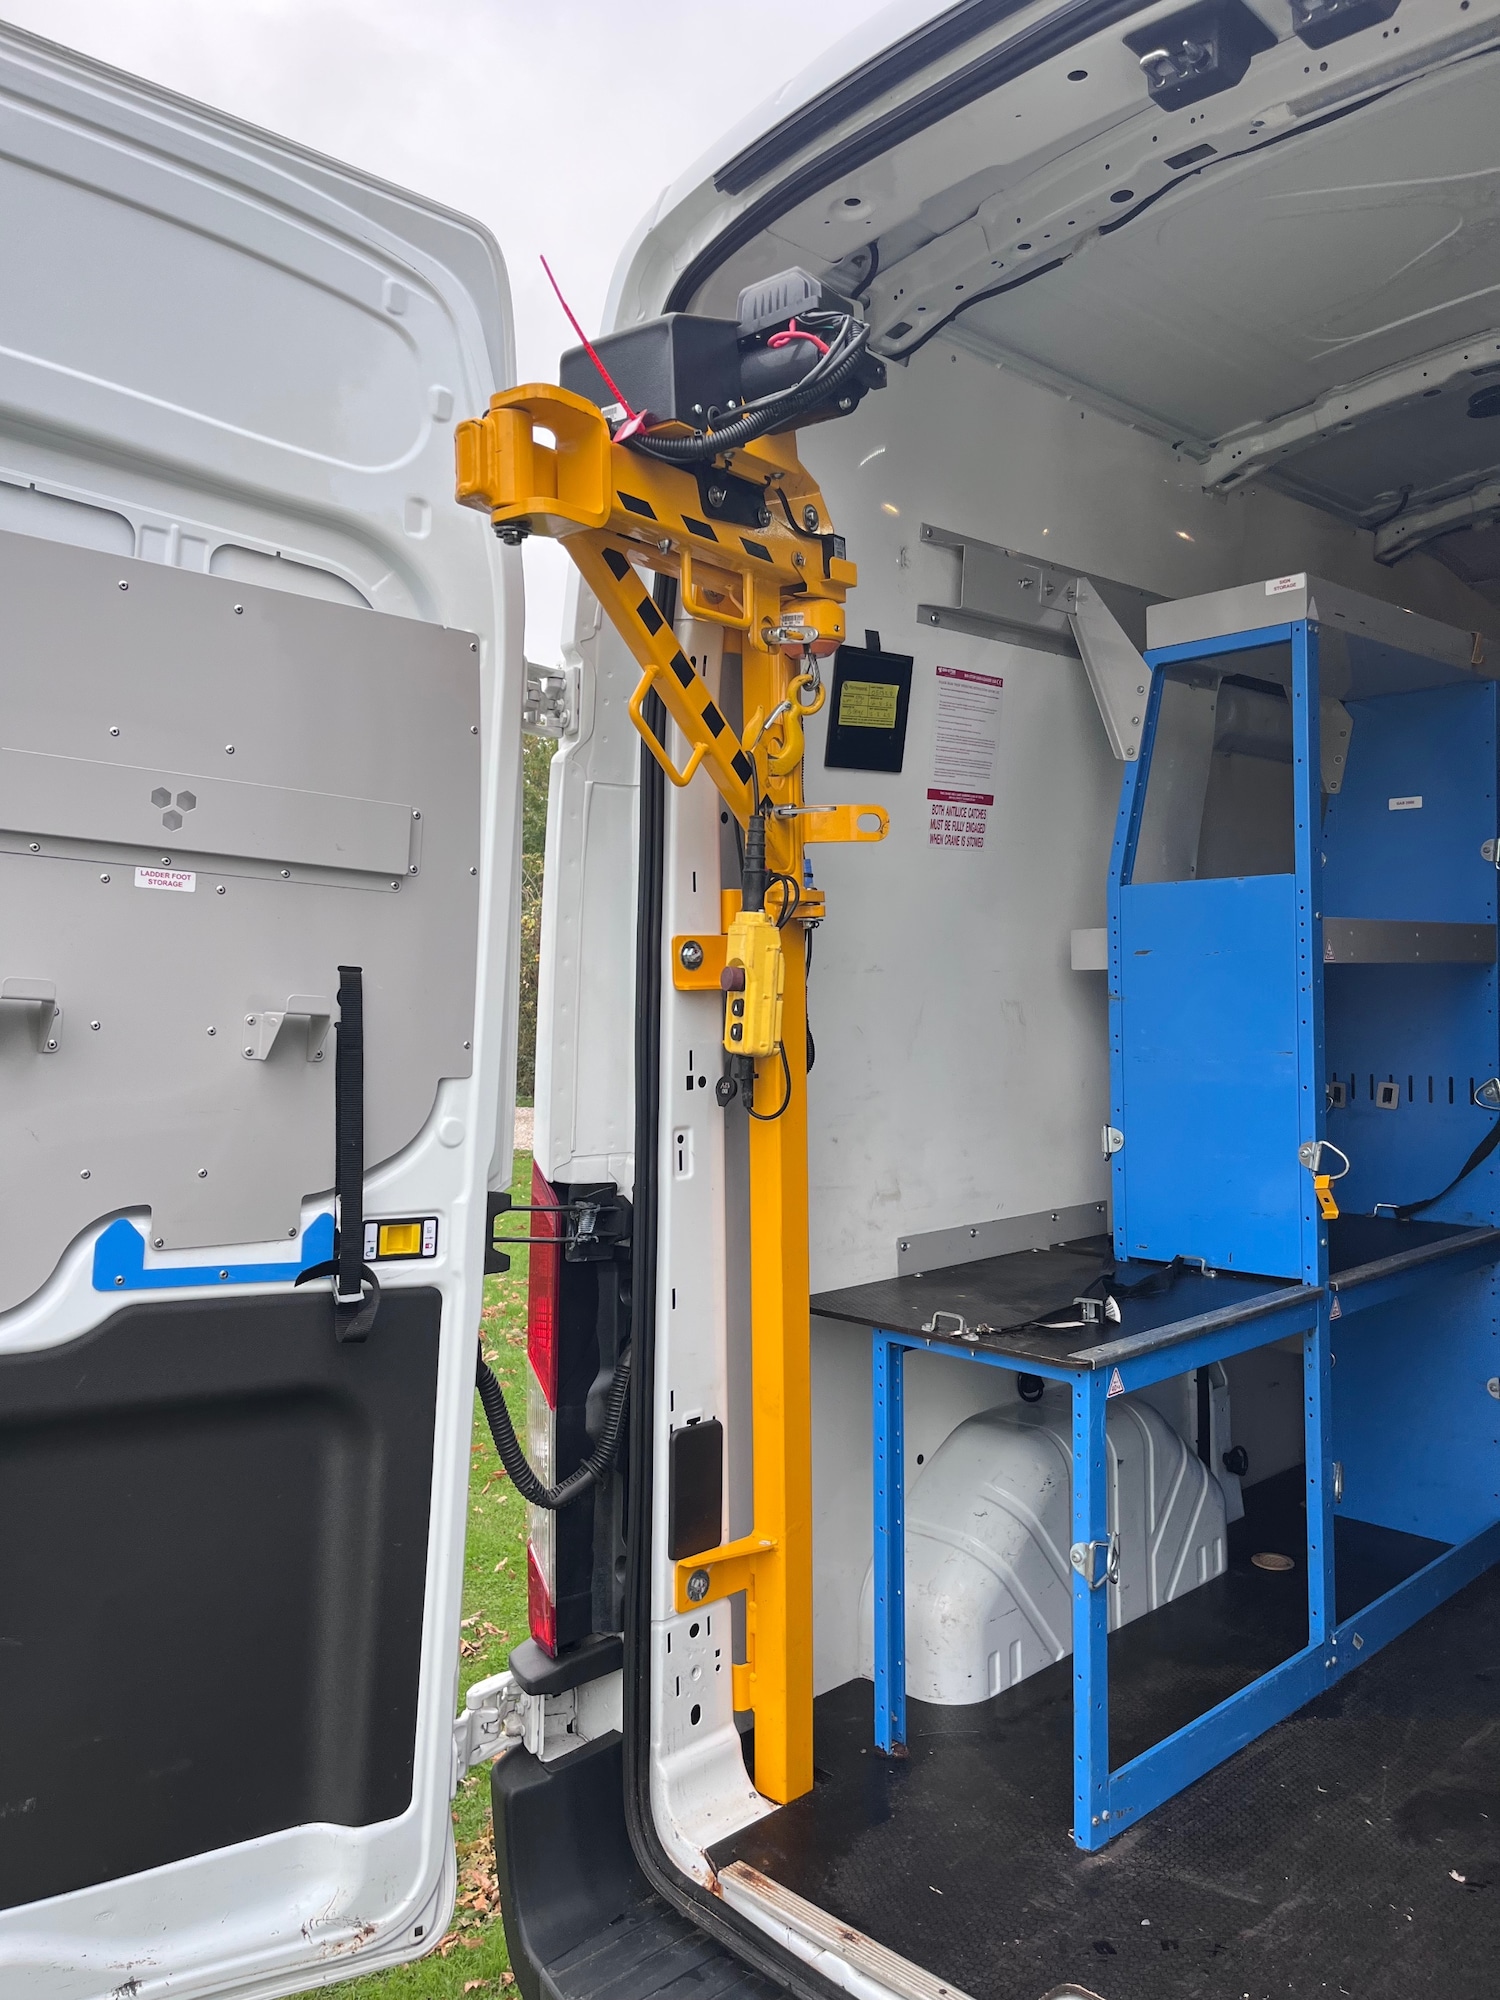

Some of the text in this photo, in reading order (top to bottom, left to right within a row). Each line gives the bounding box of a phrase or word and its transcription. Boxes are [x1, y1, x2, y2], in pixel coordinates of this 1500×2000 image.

[932, 804, 986, 820] BOTH ANTILUCE CATCHES
[930, 818, 986, 834] MUST BE FULLY ENGAGED
[930, 834, 984, 848] WHEN CRANE IS STOWED
[140, 870, 191, 880] LADDER FOOT
[148, 878, 183, 888] STORAGE
